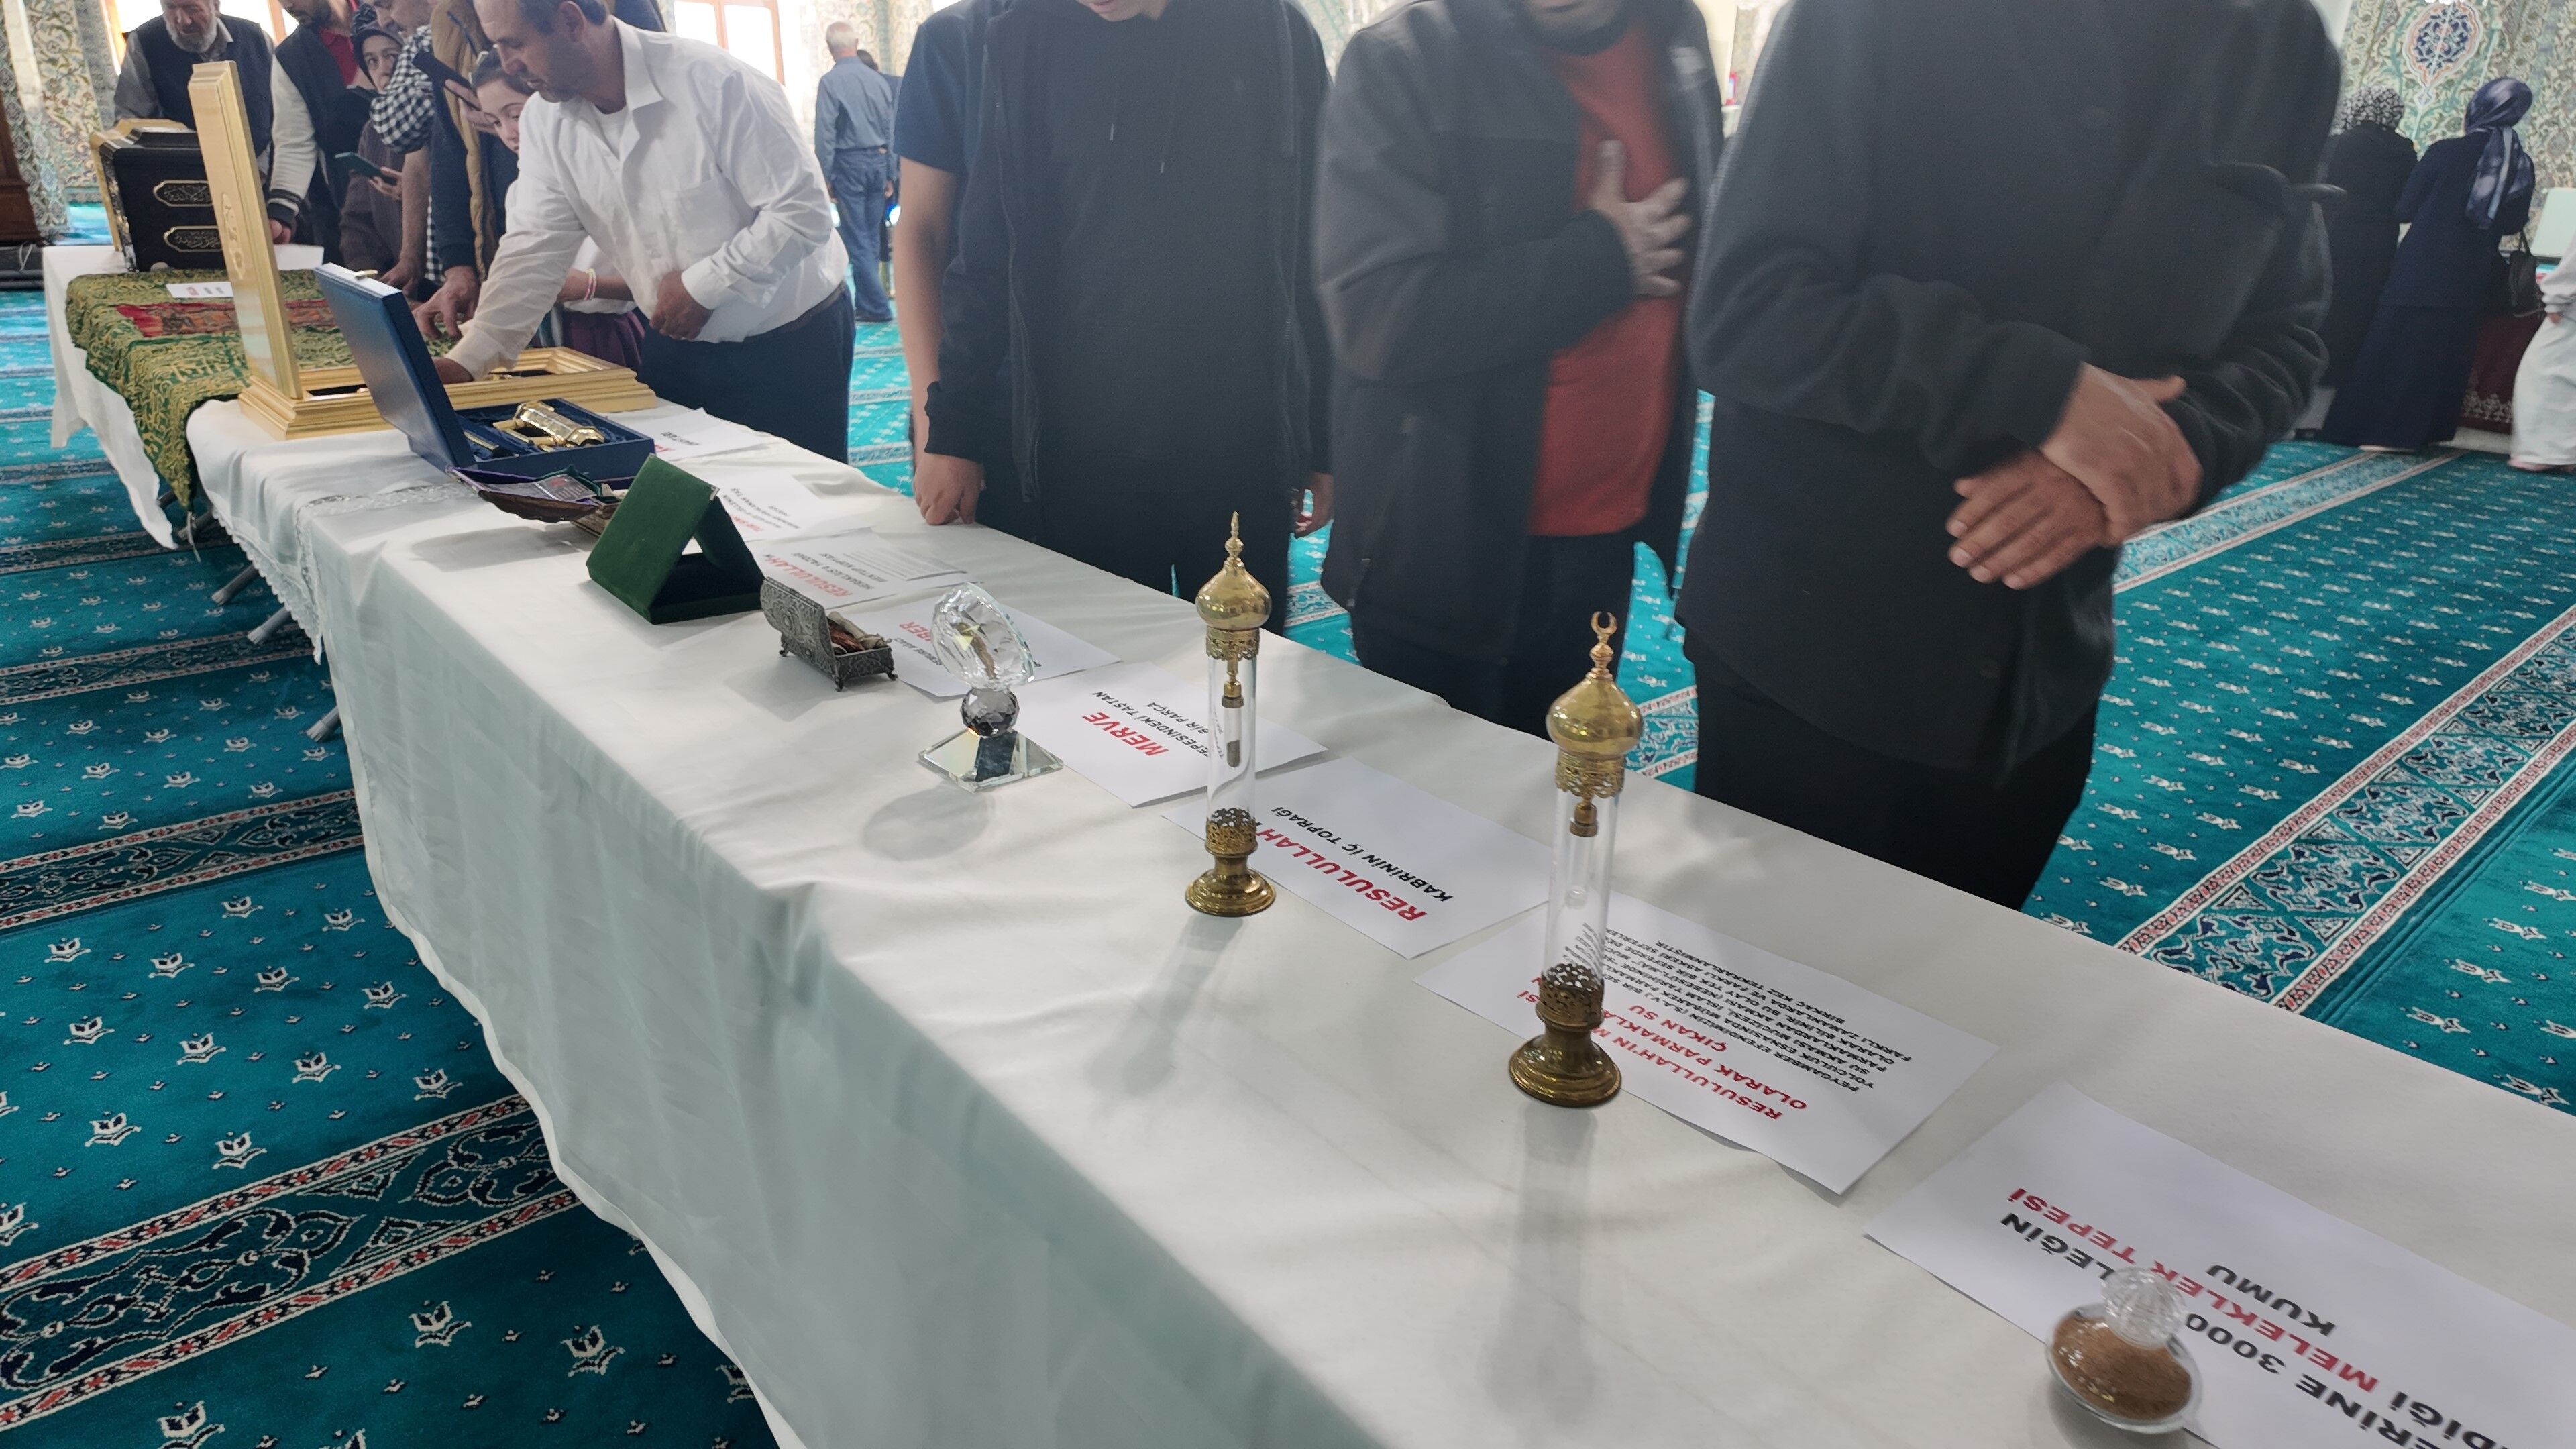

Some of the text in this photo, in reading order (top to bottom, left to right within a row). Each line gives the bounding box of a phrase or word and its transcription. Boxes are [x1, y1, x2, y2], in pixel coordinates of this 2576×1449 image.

[1092, 692, 1139, 716] TAŞTAN
[1147, 702, 1209, 734] BİR PARÇA
[1083, 712, 1166, 756] MERVE
[1271, 807, 1453, 902] KABRİNİN İÇ TOPRAĞI
[1623, 946, 1675, 970] SEFERDE
[1656, 941, 1764, 991] TEKRARLANMIŞTIR
[1659, 953, 1703, 972] ASKERİ
[1621, 963, 1682, 994] TARİHİNDE
[1621, 983, 1643, 994] BİR
[1676, 969, 1698, 980] BİR
[1699, 978, 1723, 991] TEK
[1704, 972, 1749, 992] FARKLI
[1660, 991, 1721, 1020] MÜBAREK
[1685, 991, 1724, 1010] İSLAM
[1725, 990, 1760, 1006] OLAY
[1750, 990, 1766, 1001] VE
[1766, 988, 1794, 1002] KEZ
[1629, 1005, 1658, 1020] SU
[1724, 998, 1774, 1022] AKMASI
[1761, 1006, 1781, 1016] BU
[1771, 999, 1860, 1040] ZAMANLARDA
[1795, 1001, 1845, 1024] BİRKAÇ
[1661, 1019, 1727, 1052] ÇIKAN
[1689, 1013, 1772, 1053] EFENDİMİZİN
[1724, 1018, 1798, 1054] ESNASINDA
[1776, 1022, 1887, 1072] PARMAKLARDAN
[1793, 1039, 1847, 1064] AKMASI
[1837, 1038, 1894, 1065] OLARAK
[1861, 1038, 1912, 1062] FARKLI
[1613, 1036, 1782, 1120] RESULULLAH'IN
[1774, 1051, 1860, 1092] PEYGAMBER
[1799, 1052, 1873, 1089] YOLCULUK
[1848, 1064, 1870, 1075] SU
[1717, 1065, 1807, 1110] OLARAK
[2008, 1188, 2134, 1264] TEPESİ
[2000, 1213, 2114, 1280] LEĞİN
[2207, 1265, 2335, 1336] KUMU
[2151, 1263, 2378, 1392] MELEKLER
[2186, 1313, 2285, 1374] 3000
